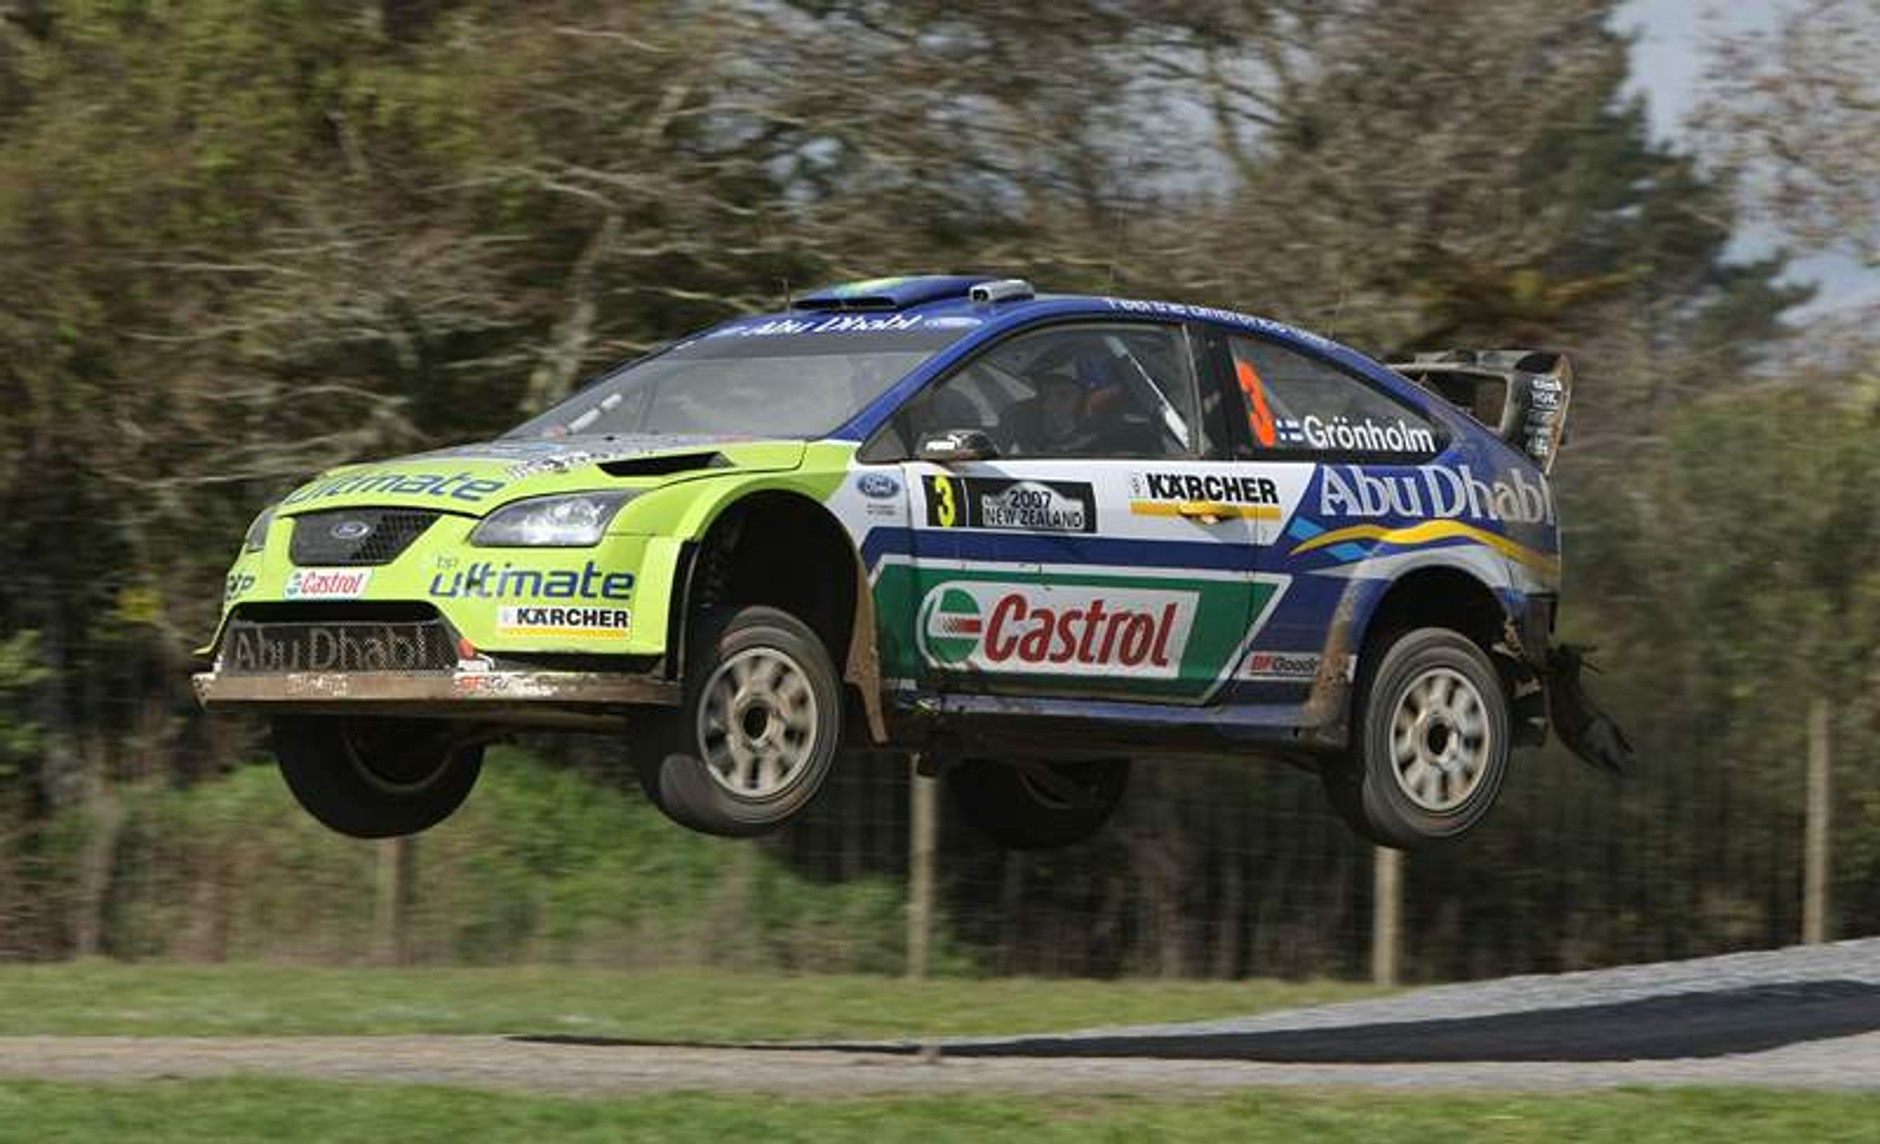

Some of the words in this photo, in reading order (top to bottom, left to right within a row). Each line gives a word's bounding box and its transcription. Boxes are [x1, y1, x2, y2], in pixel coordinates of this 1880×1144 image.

[1237, 360, 1276, 449] 3
[1303, 413, 1437, 454] Grönholm
[934, 474, 957, 528] 3
[1009, 489, 1052, 509] 2007
[1146, 474, 1279, 504] KÄRCHER
[1318, 465, 1422, 517] Abu
[985, 507, 1017, 527] NEW
[1020, 509, 1084, 528] ZEALAND
[301, 572, 363, 594] Castrol
[429, 561, 635, 600] ultimate
[517, 607, 629, 628] KÄRCHER
[983, 594, 1178, 667] Castrol
[235, 631, 301, 670] Abu
